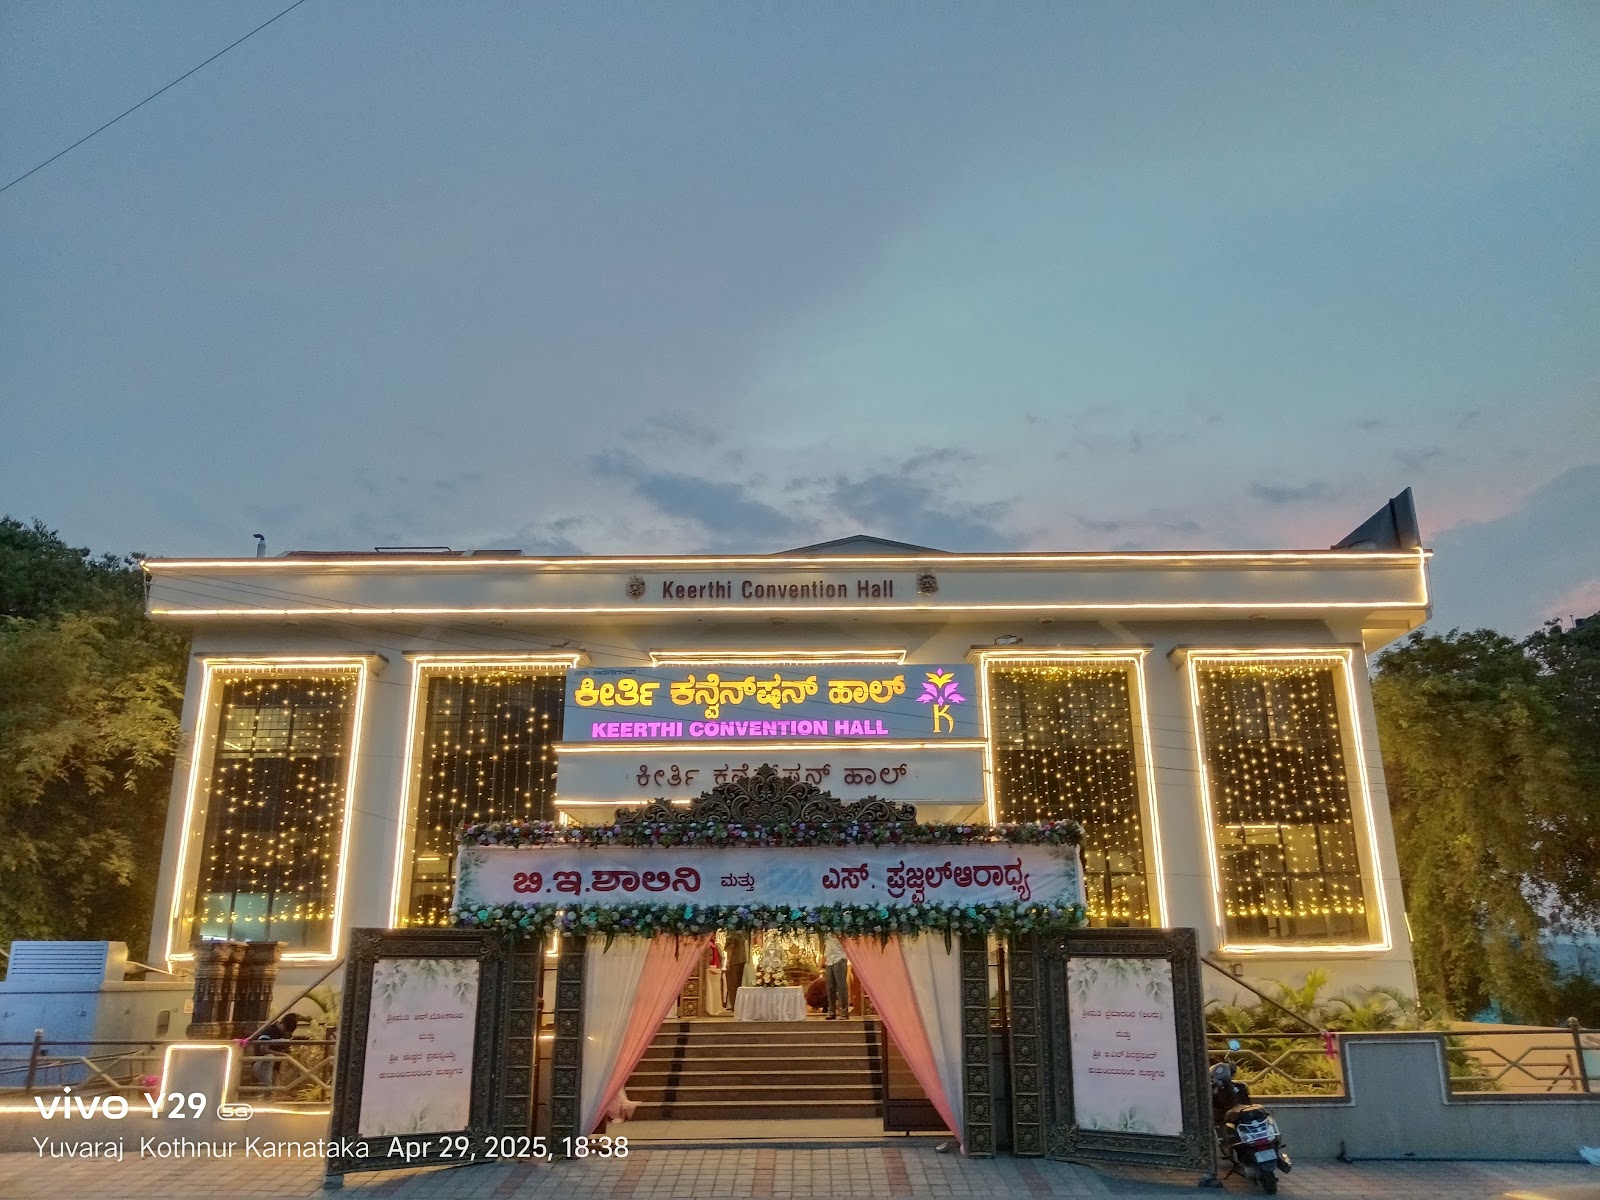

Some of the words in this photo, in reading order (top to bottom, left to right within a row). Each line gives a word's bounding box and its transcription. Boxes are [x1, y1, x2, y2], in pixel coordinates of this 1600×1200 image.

[662, 580, 731, 599] Keerthi
[741, 580, 848, 599] Convention
[857, 579, 894, 598] Hall
[574, 677, 661, 707] ಕೀರ್ತಿ
[828, 675, 906, 704] ಹಾಲ್
[592, 722, 683, 738] KEERTHI
[689, 720, 828, 738] CONVENTION
[834, 719, 889, 735] HALL
[636, 764, 700, 786] ಕೀರ್ತಿ
[844, 763, 908, 785] ಹಾಲ್
[720, 873, 756, 892] ಮತ್ತು
